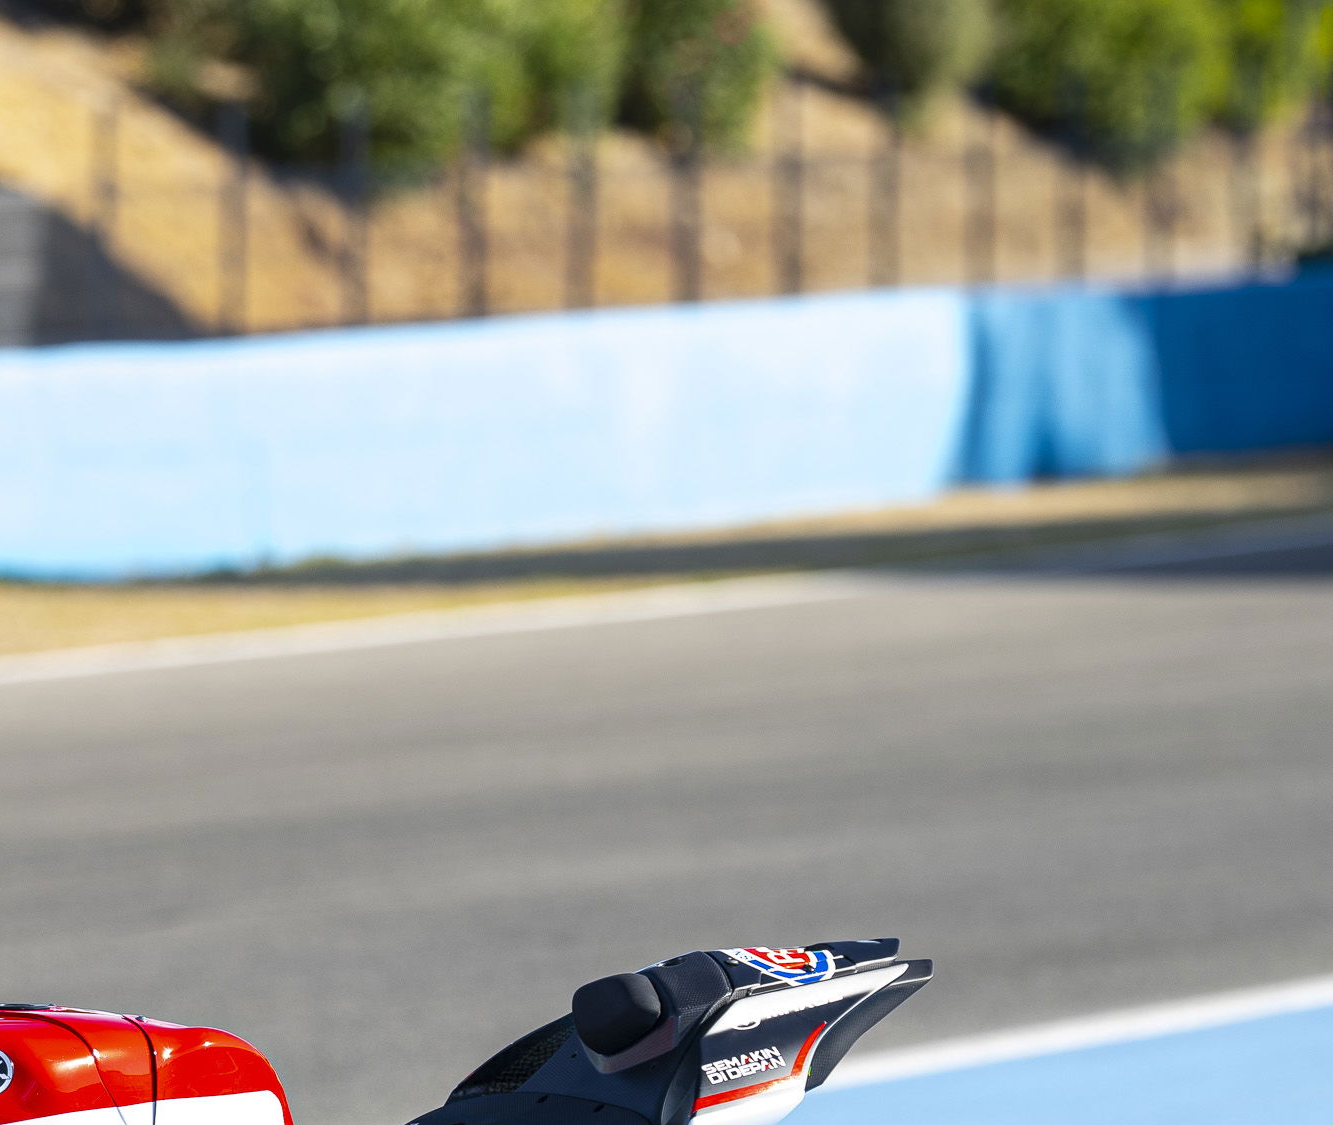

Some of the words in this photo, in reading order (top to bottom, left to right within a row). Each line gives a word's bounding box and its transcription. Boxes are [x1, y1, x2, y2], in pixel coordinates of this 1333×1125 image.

[701, 1046, 781, 1074] SEMAKIN
[706, 1069, 729, 1085] DI
[726, 1055, 786, 1080] DEPAN
